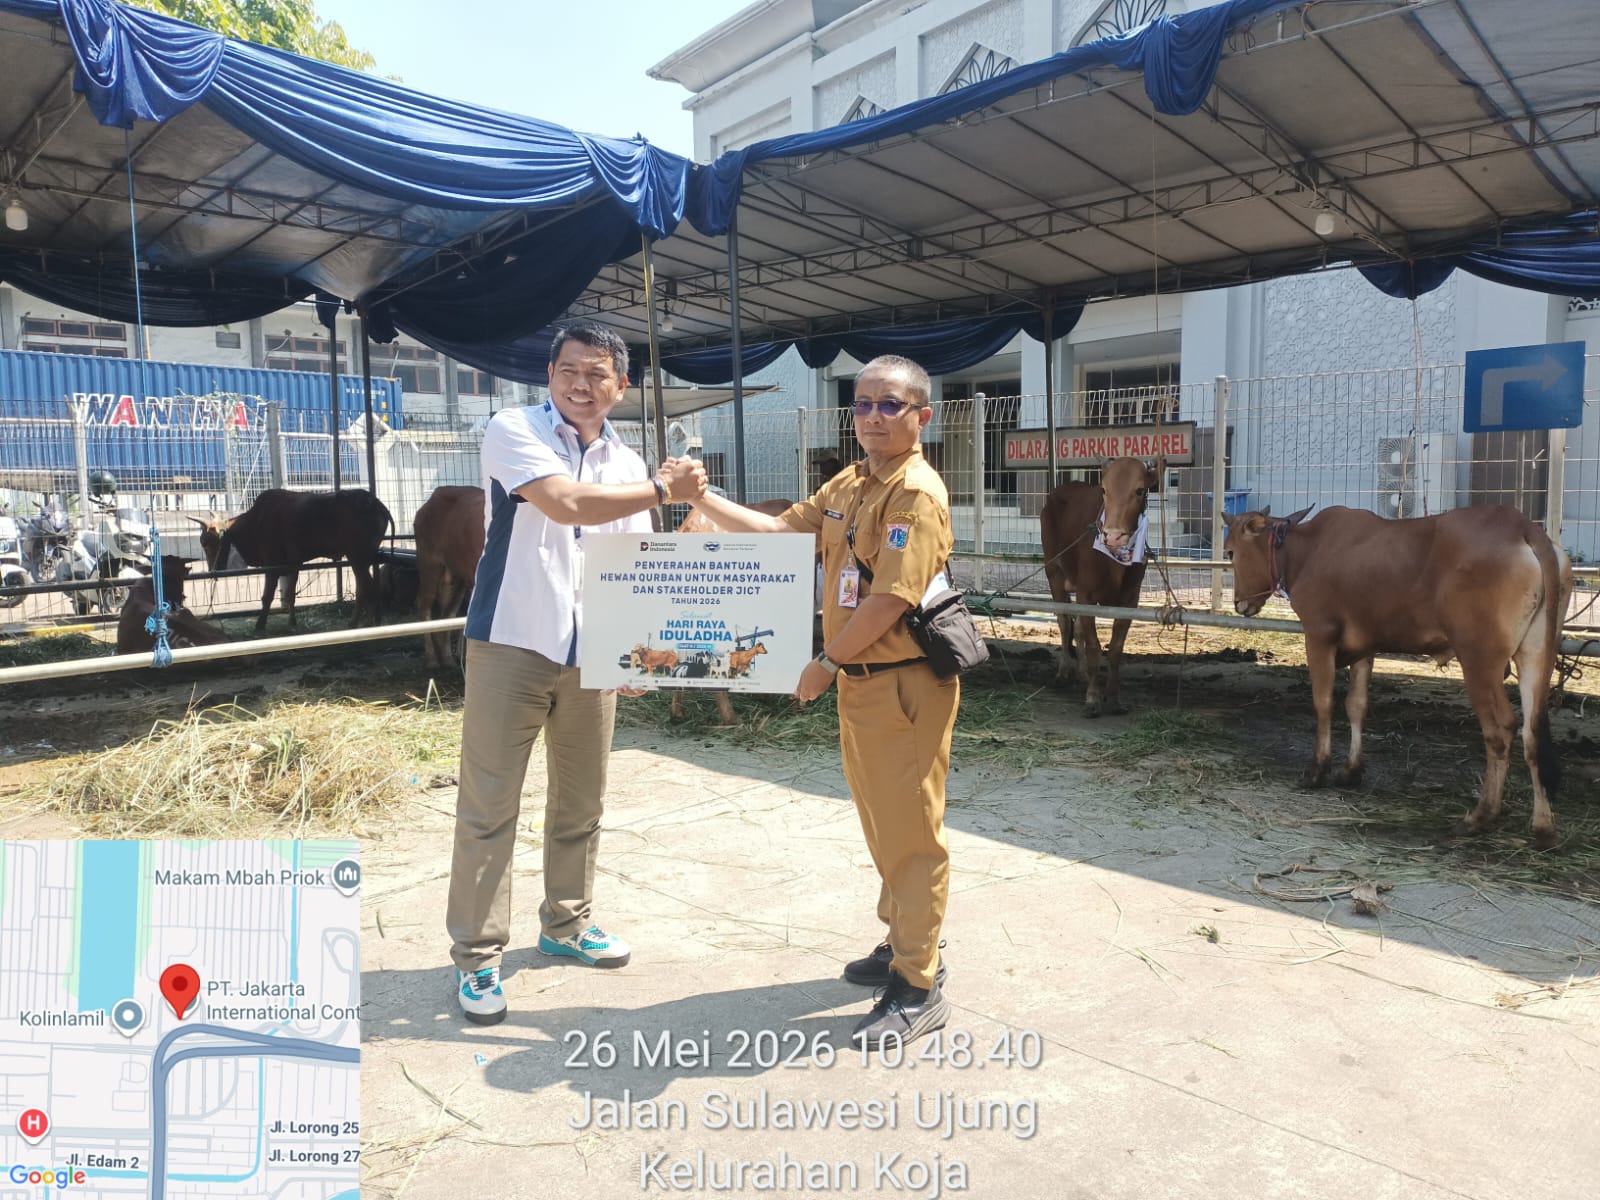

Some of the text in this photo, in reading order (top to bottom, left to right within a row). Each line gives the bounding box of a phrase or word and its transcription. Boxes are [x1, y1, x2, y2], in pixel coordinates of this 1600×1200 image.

[73, 393, 173, 429] WAN
[1072, 436, 1120, 458] PARKIR
[1123, 433, 1188, 456] PARAREL
[635, 561, 760, 570] PENYERAHAN BANTUAN
[600, 573, 796, 583] HEWAN QURBAN UNTUK MASYARAKAT
[632, 585, 761, 595] DAN STAKEHOLDER JICT
[671, 597, 698, 605] TAHUN
[666, 619, 726, 629] HARI RAYA
[659, 630, 733, 641] IDULADHA
